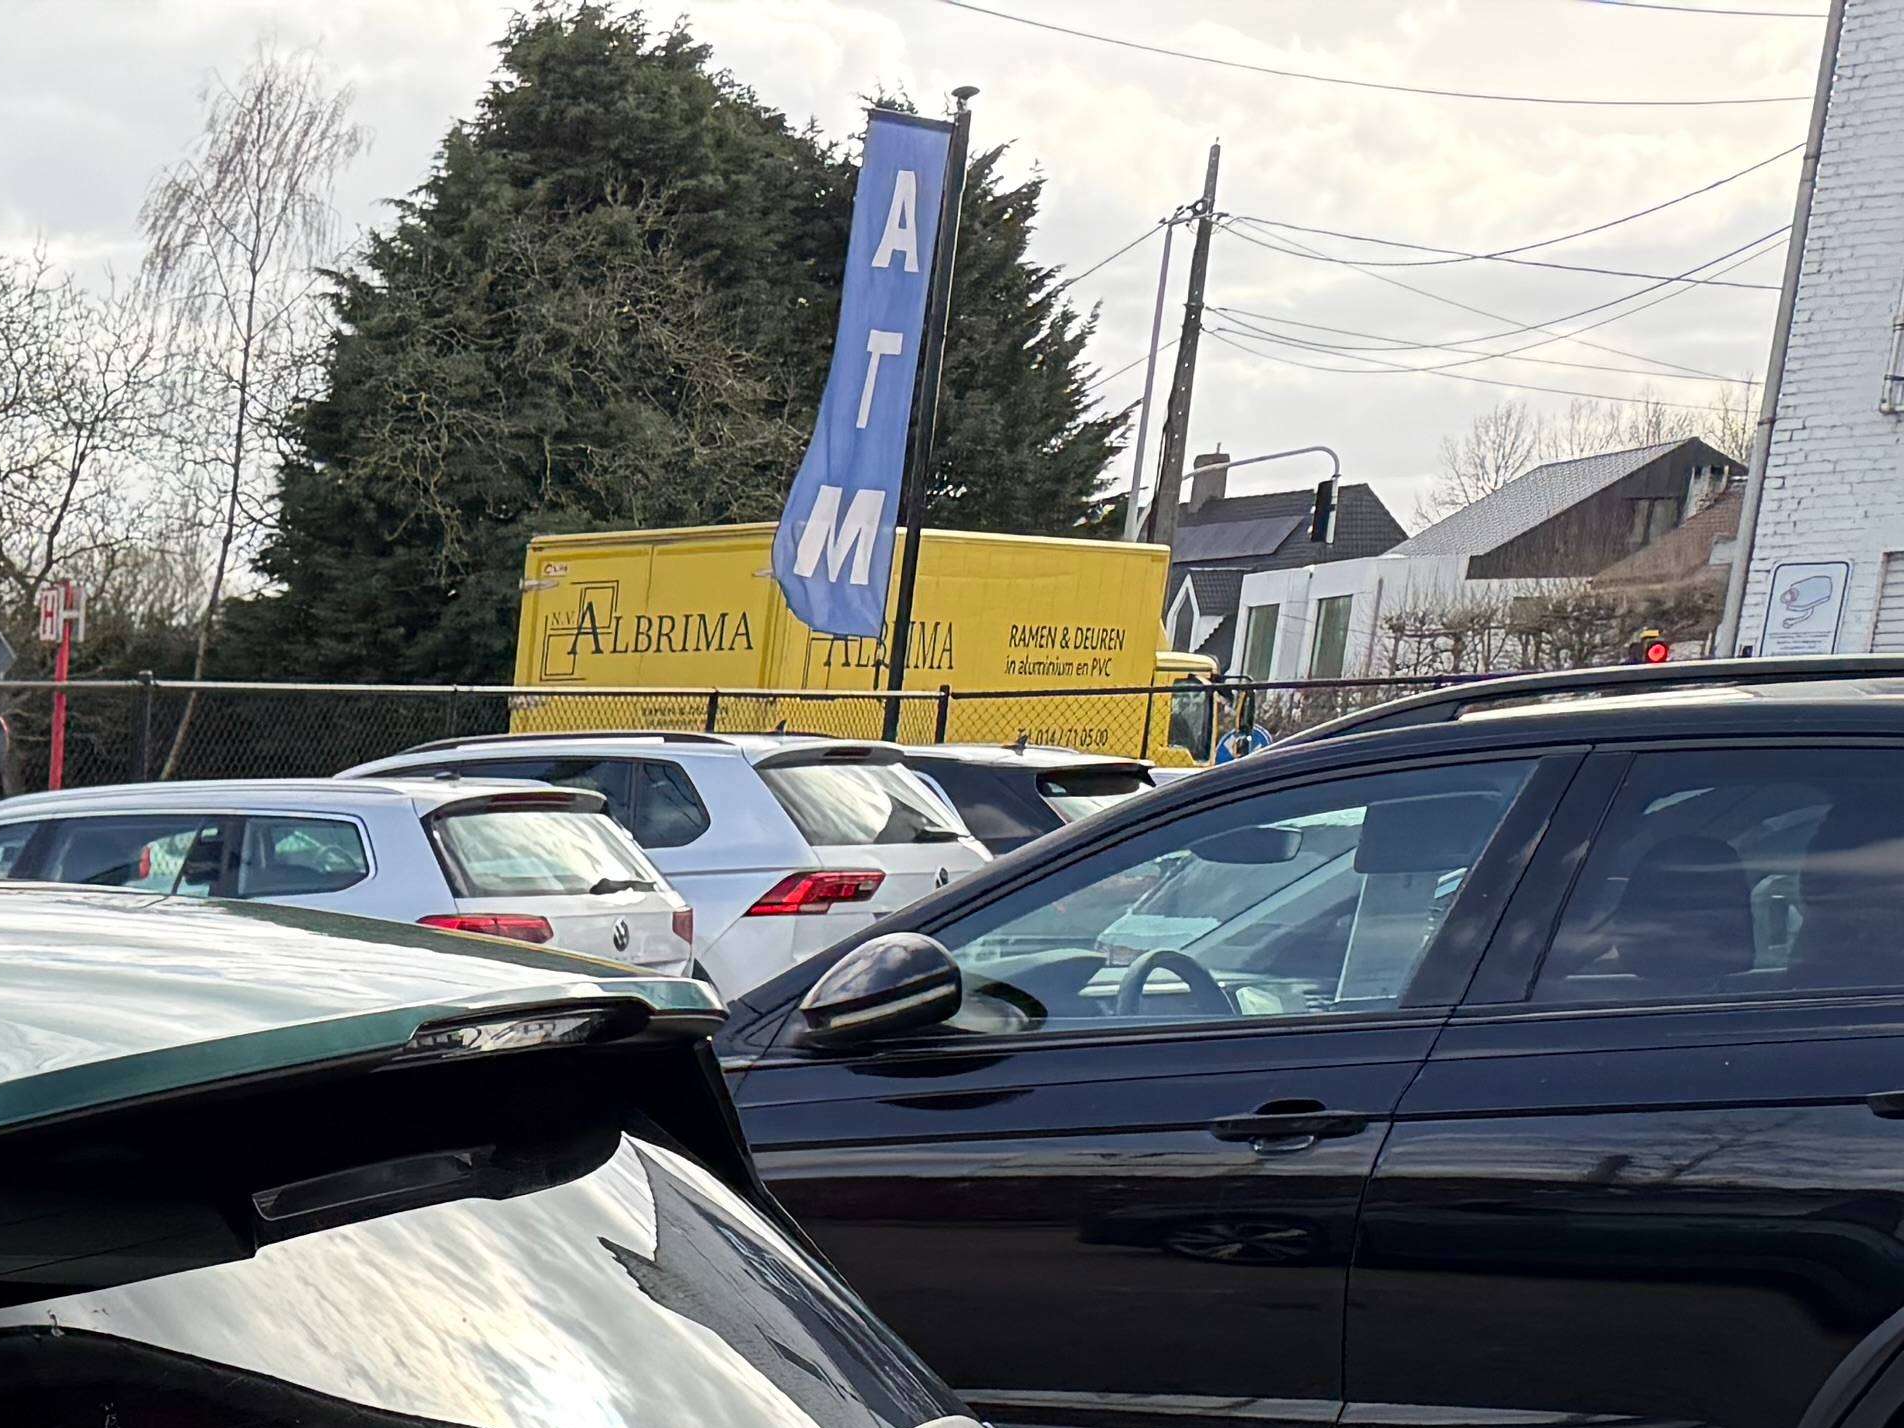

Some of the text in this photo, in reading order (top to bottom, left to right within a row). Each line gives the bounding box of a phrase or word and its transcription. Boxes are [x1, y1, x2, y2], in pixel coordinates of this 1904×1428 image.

[567, 601, 754, 655] ALBRIMA
[1009, 624, 1126, 651] RAMEN & DEUREN
[1005, 654, 1112, 677] in aluminium en PVC
